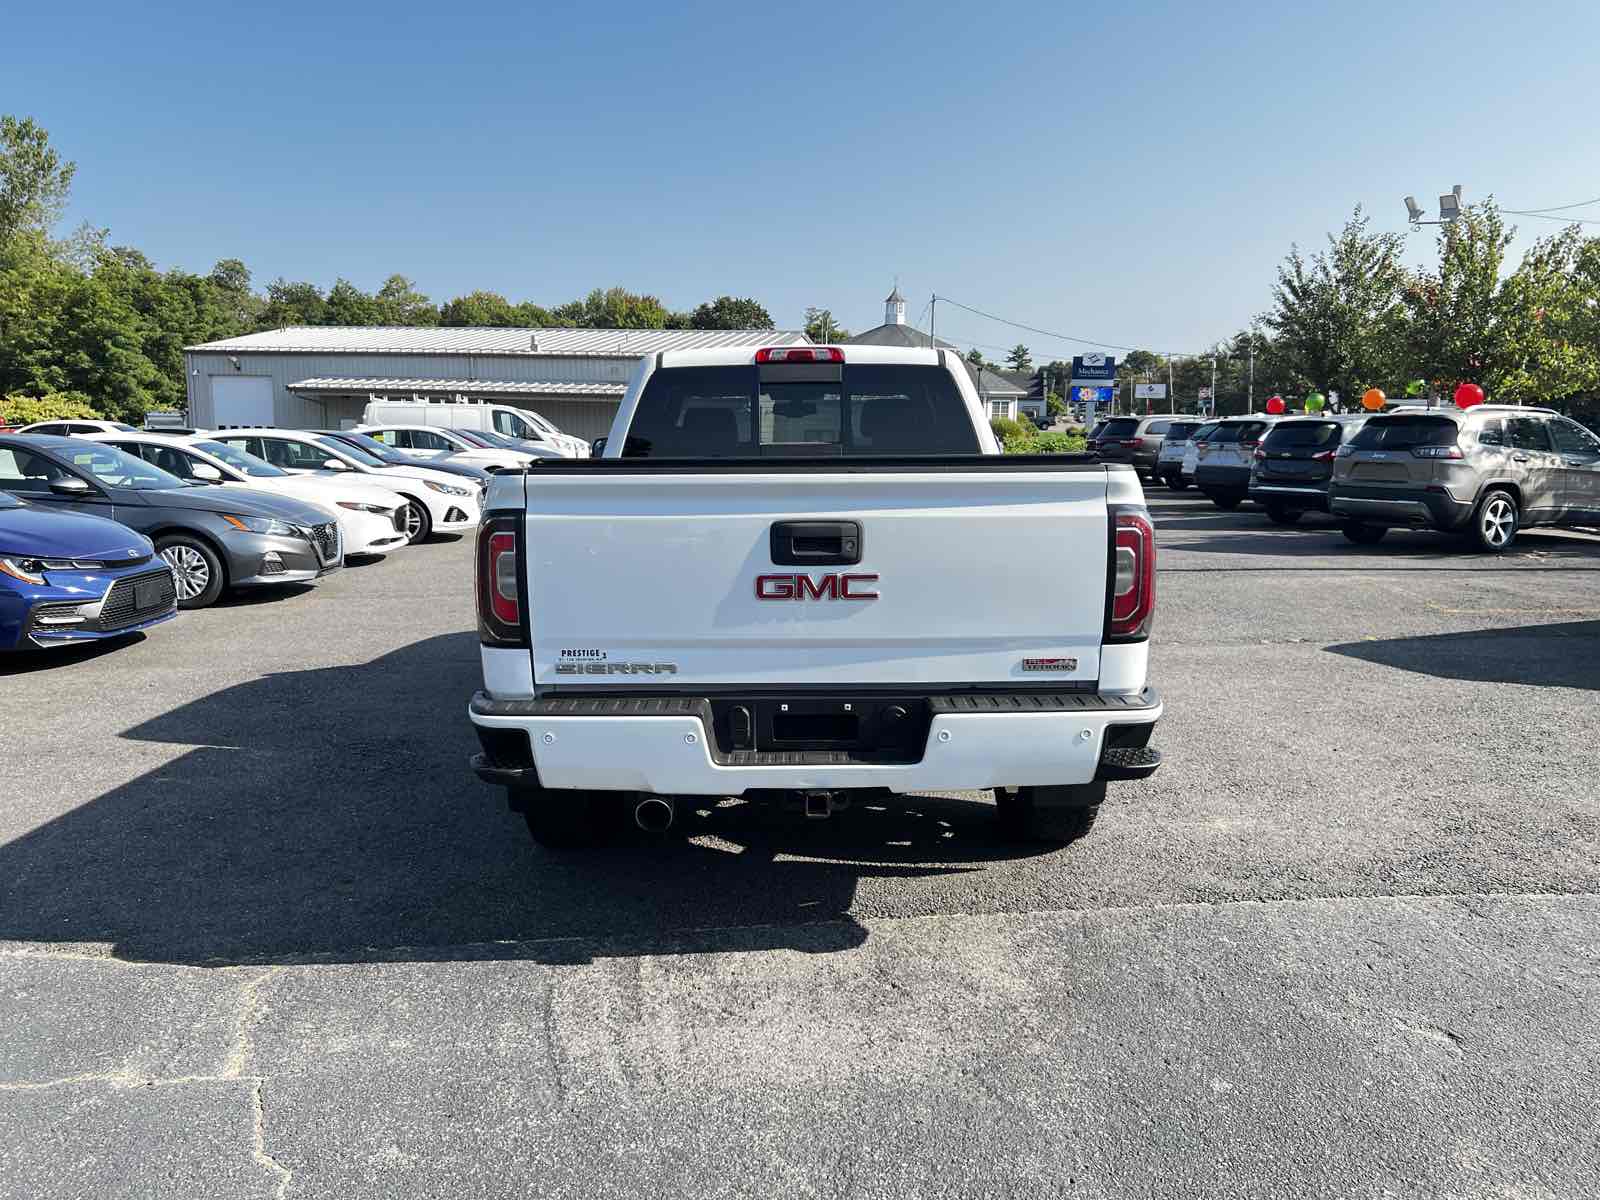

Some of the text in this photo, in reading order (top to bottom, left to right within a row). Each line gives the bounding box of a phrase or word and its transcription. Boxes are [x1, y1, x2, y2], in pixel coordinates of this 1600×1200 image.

[755, 573, 880, 600] GMC
[561, 649, 600, 657] PRESTIGE
[555, 664, 677, 675] SIERRA
